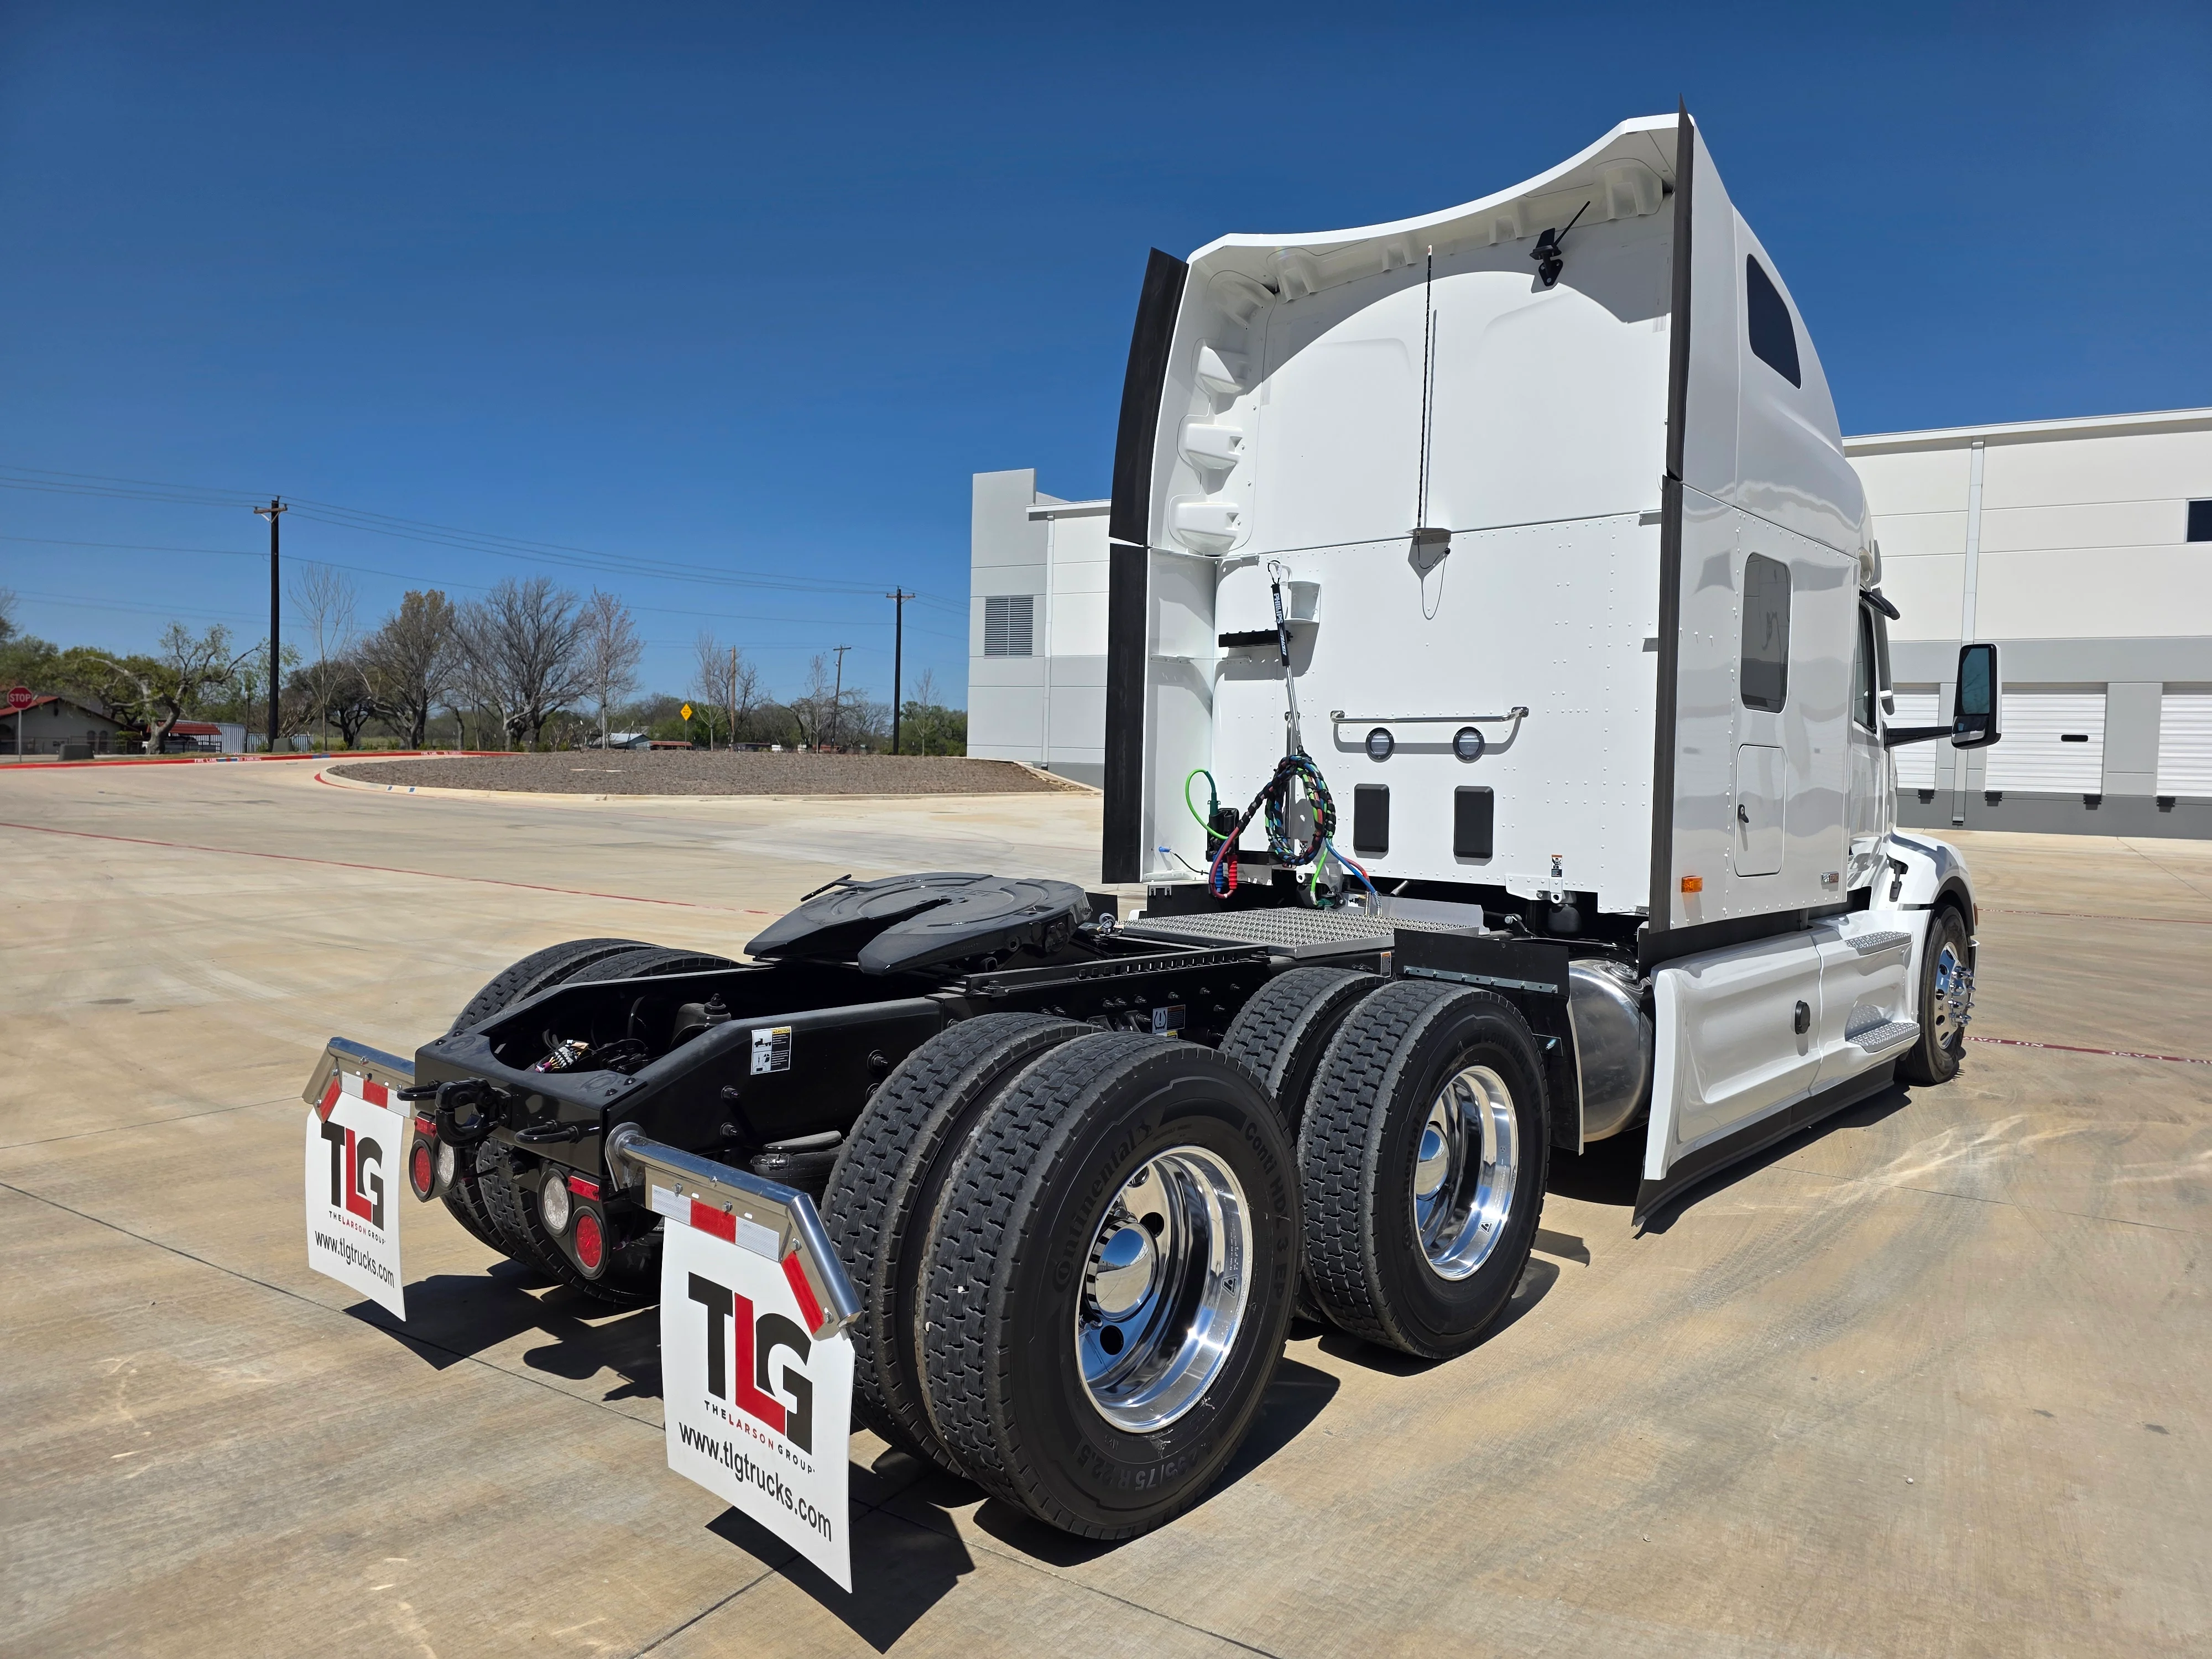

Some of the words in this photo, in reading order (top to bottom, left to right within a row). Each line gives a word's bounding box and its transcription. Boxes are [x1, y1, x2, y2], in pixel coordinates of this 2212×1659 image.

[1274, 593, 1283, 624] PHILLIPS
[9, 693, 31, 702] STOP
[321, 1120, 384, 1231] TLG
[1052, 1131, 1137, 1293] Continental
[1245, 1121, 1278, 1176] Conti
[1274, 1262, 1287, 1300] EP
[315, 1230, 395, 1288] www.tlgtrucks.com
[368, 1230, 385, 1245] GROUP
[688, 1271, 813, 1455] TLG
[678, 1421, 832, 1543] www.tlgtrucks.com
[778, 1444, 813, 1474] GROUP
